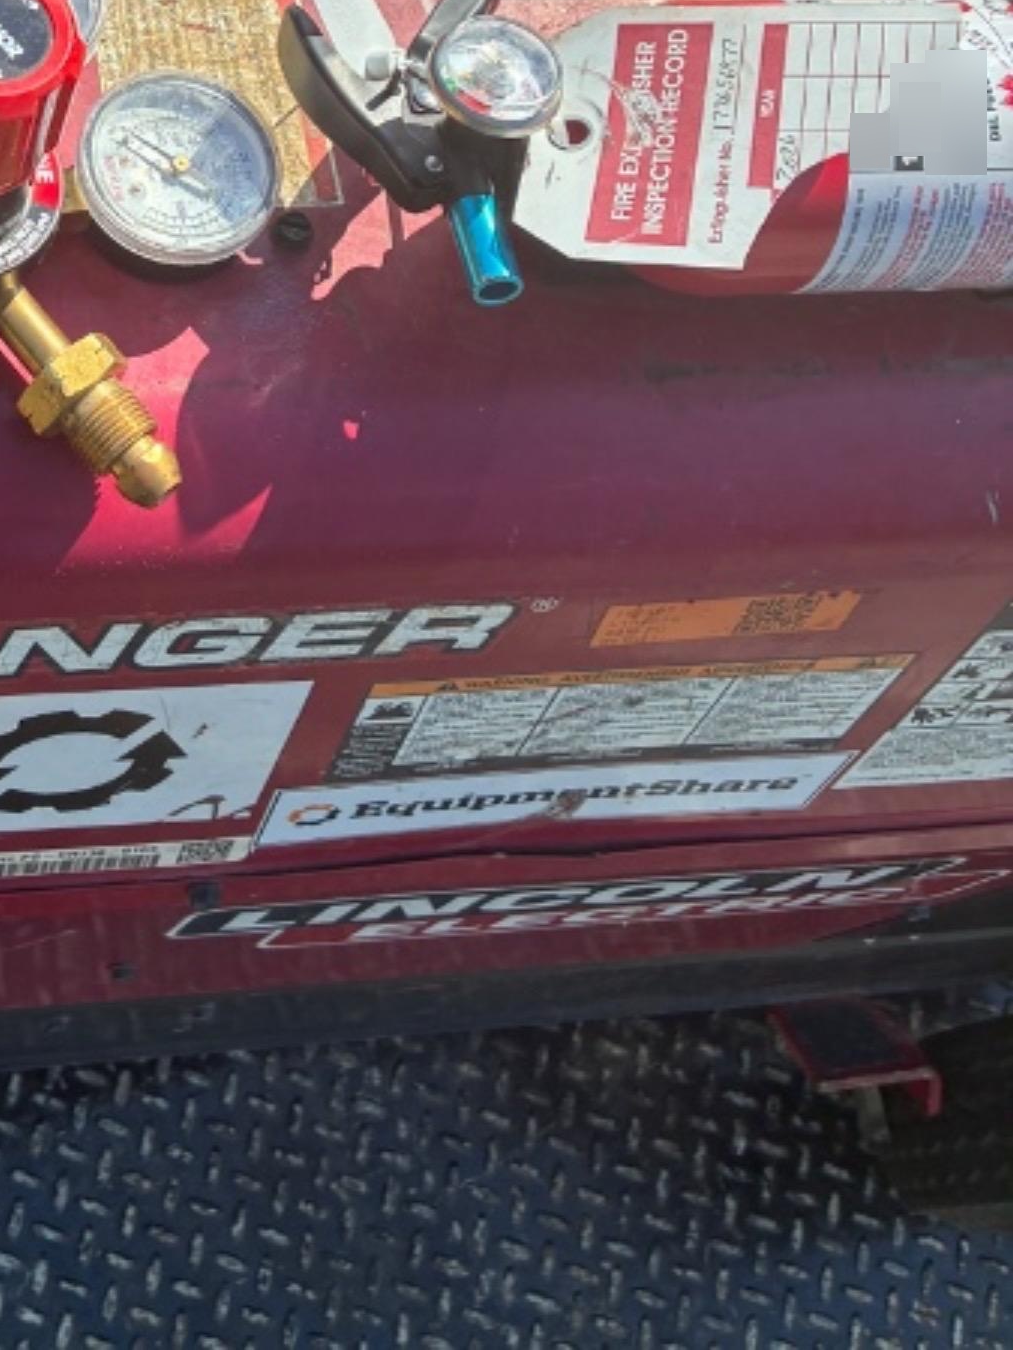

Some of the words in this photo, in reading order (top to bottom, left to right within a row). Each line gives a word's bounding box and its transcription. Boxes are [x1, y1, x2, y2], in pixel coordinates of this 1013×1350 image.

[618, 40, 657, 176] EXISHER
[641, 116, 678, 235] INSPECTION
[660, 28, 689, 114] RECORD
[611, 182, 637, 220] FIRE
[349, 773, 799, 822] EquipmentShare
[217, 864, 902, 933] LINCOLN
[357, 884, 908, 942] ELECTRIC
